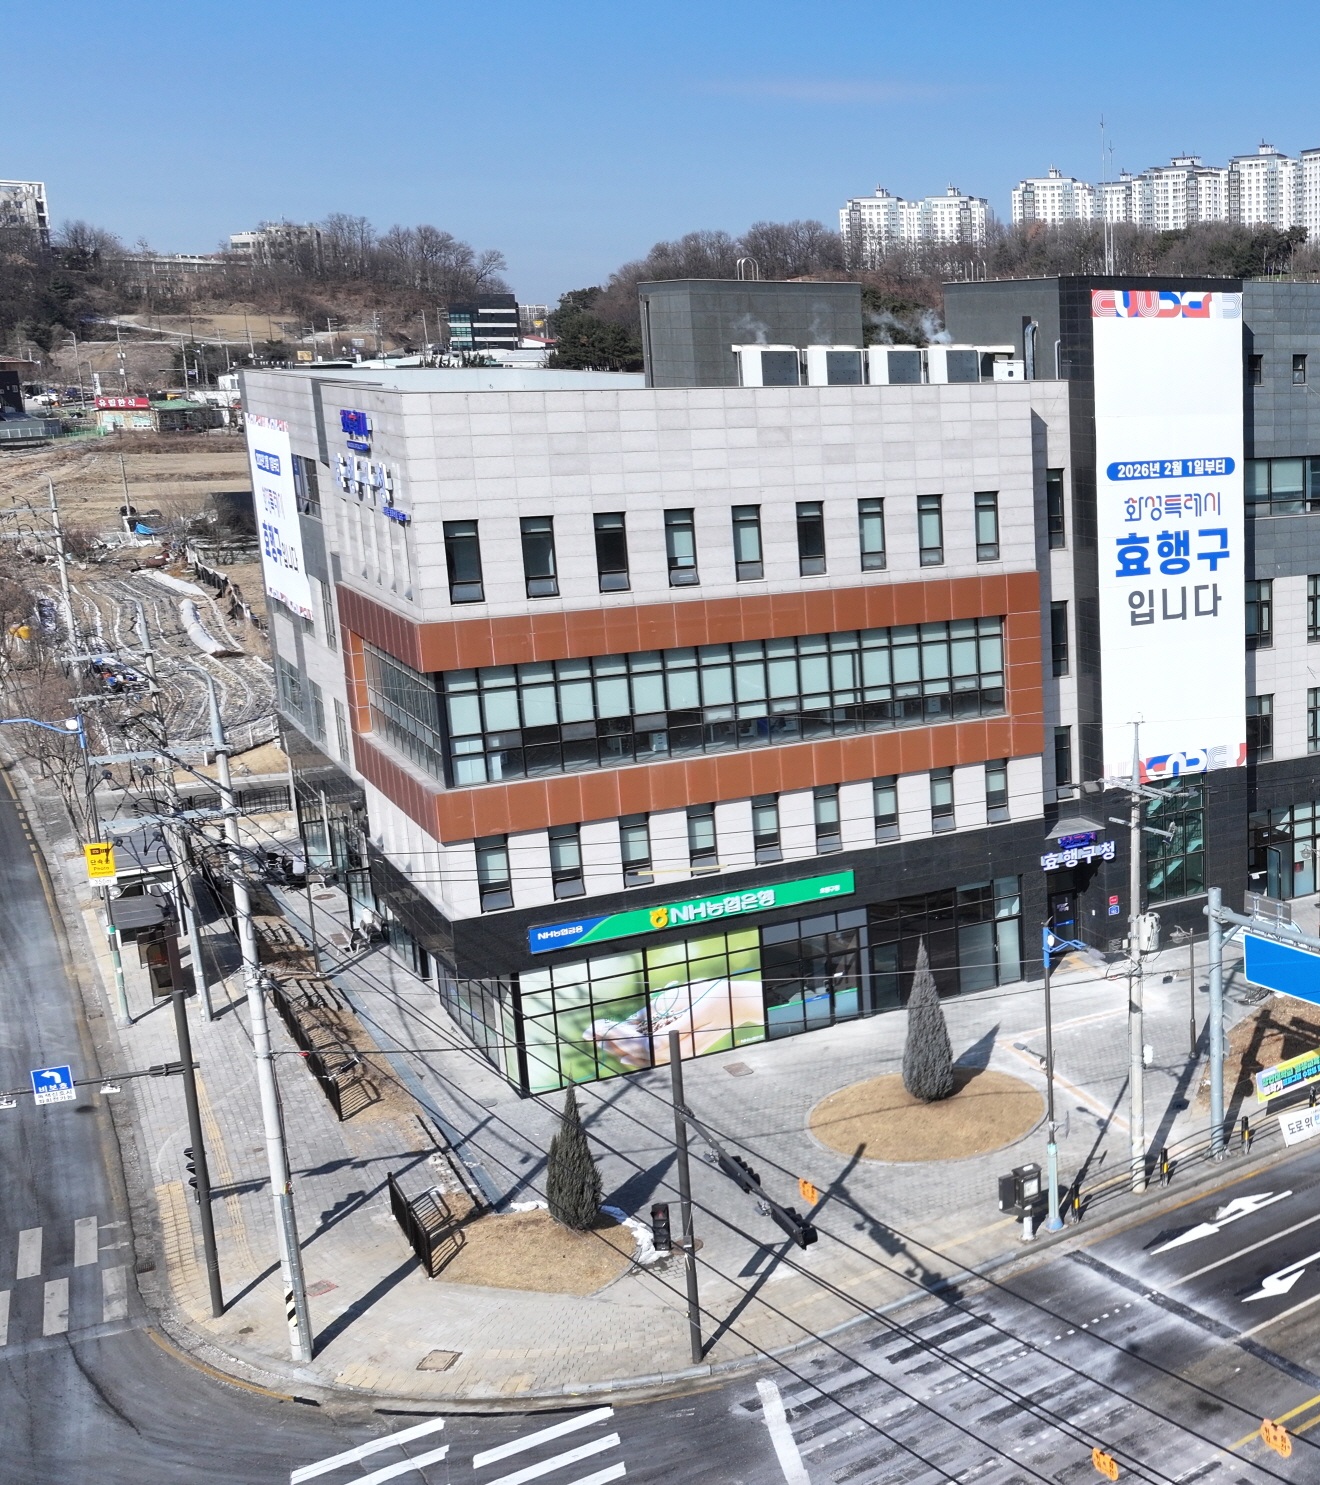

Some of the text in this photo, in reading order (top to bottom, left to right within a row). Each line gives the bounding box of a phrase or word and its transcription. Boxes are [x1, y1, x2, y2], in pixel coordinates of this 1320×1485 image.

[1117, 459, 1226, 478] 2026년 2월 1일부터
[1124, 491, 1220, 522] 화성특례시
[1115, 528, 1231, 578] 효행구
[1128, 583, 1223, 627] 입니다
[1043, 841, 1116, 871] 효행구청
[670, 889, 775, 923] NH농협은행
[38, 1082, 68, 1093] 비보호
[1288, 1119, 1304, 1135] 도로
[1304, 1117, 1314, 1128] 위
